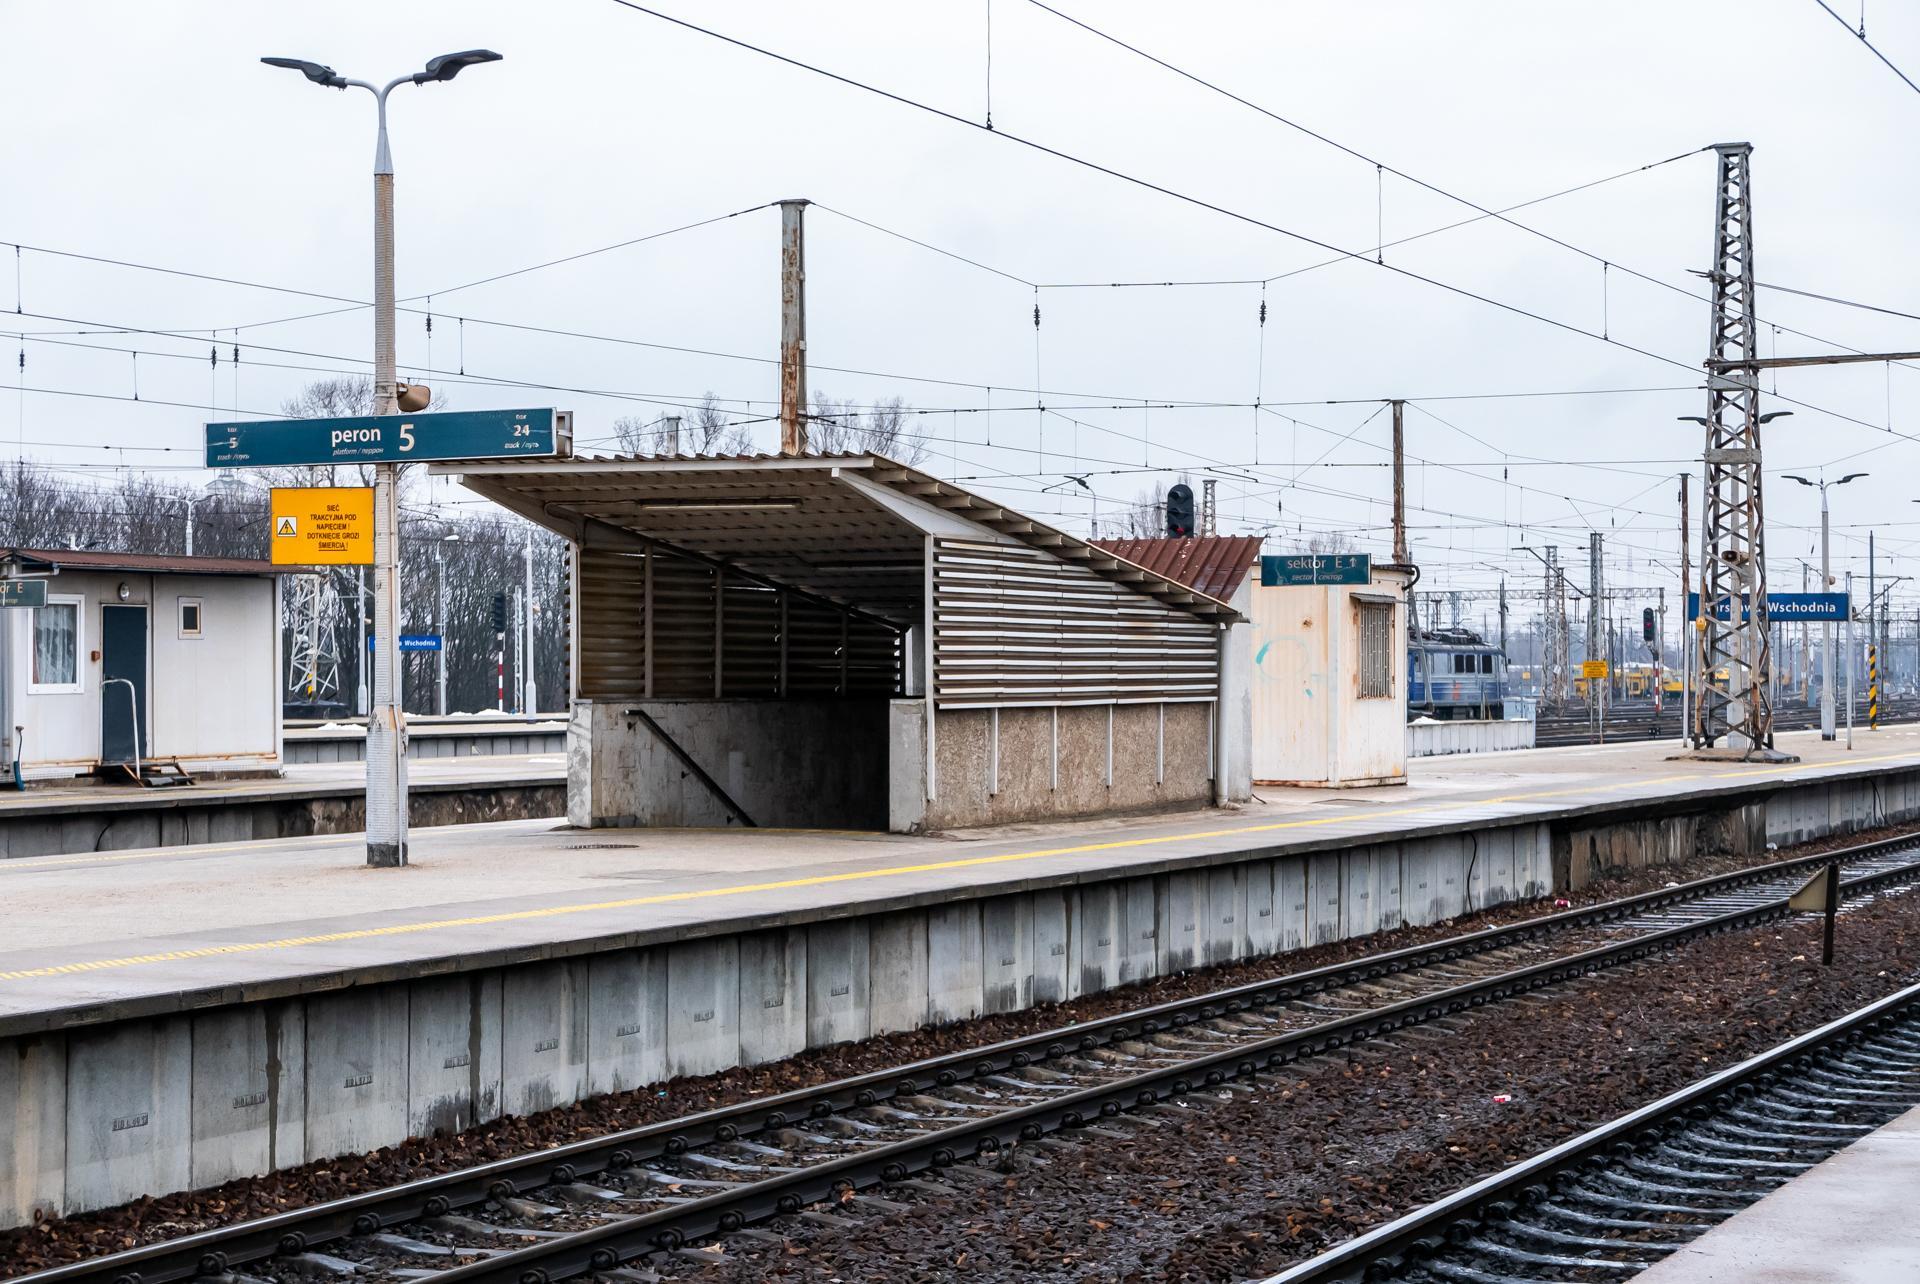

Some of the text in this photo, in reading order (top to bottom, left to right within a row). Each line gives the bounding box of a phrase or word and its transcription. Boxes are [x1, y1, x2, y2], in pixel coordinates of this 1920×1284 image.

[513, 424, 530, 437] 24
[229, 437, 239, 449] 5
[331, 423, 415, 452] peron 5
[332, 447, 357, 457] platform
[326, 504, 340, 512] SIEĆ
[342, 532, 360, 540] GROZI
[1287, 556, 1343, 568] sektor E
[17, 582, 24, 594] E
[1768, 601, 1836, 613] Wschodnia
[404, 639, 436, 647] Wschodnia
